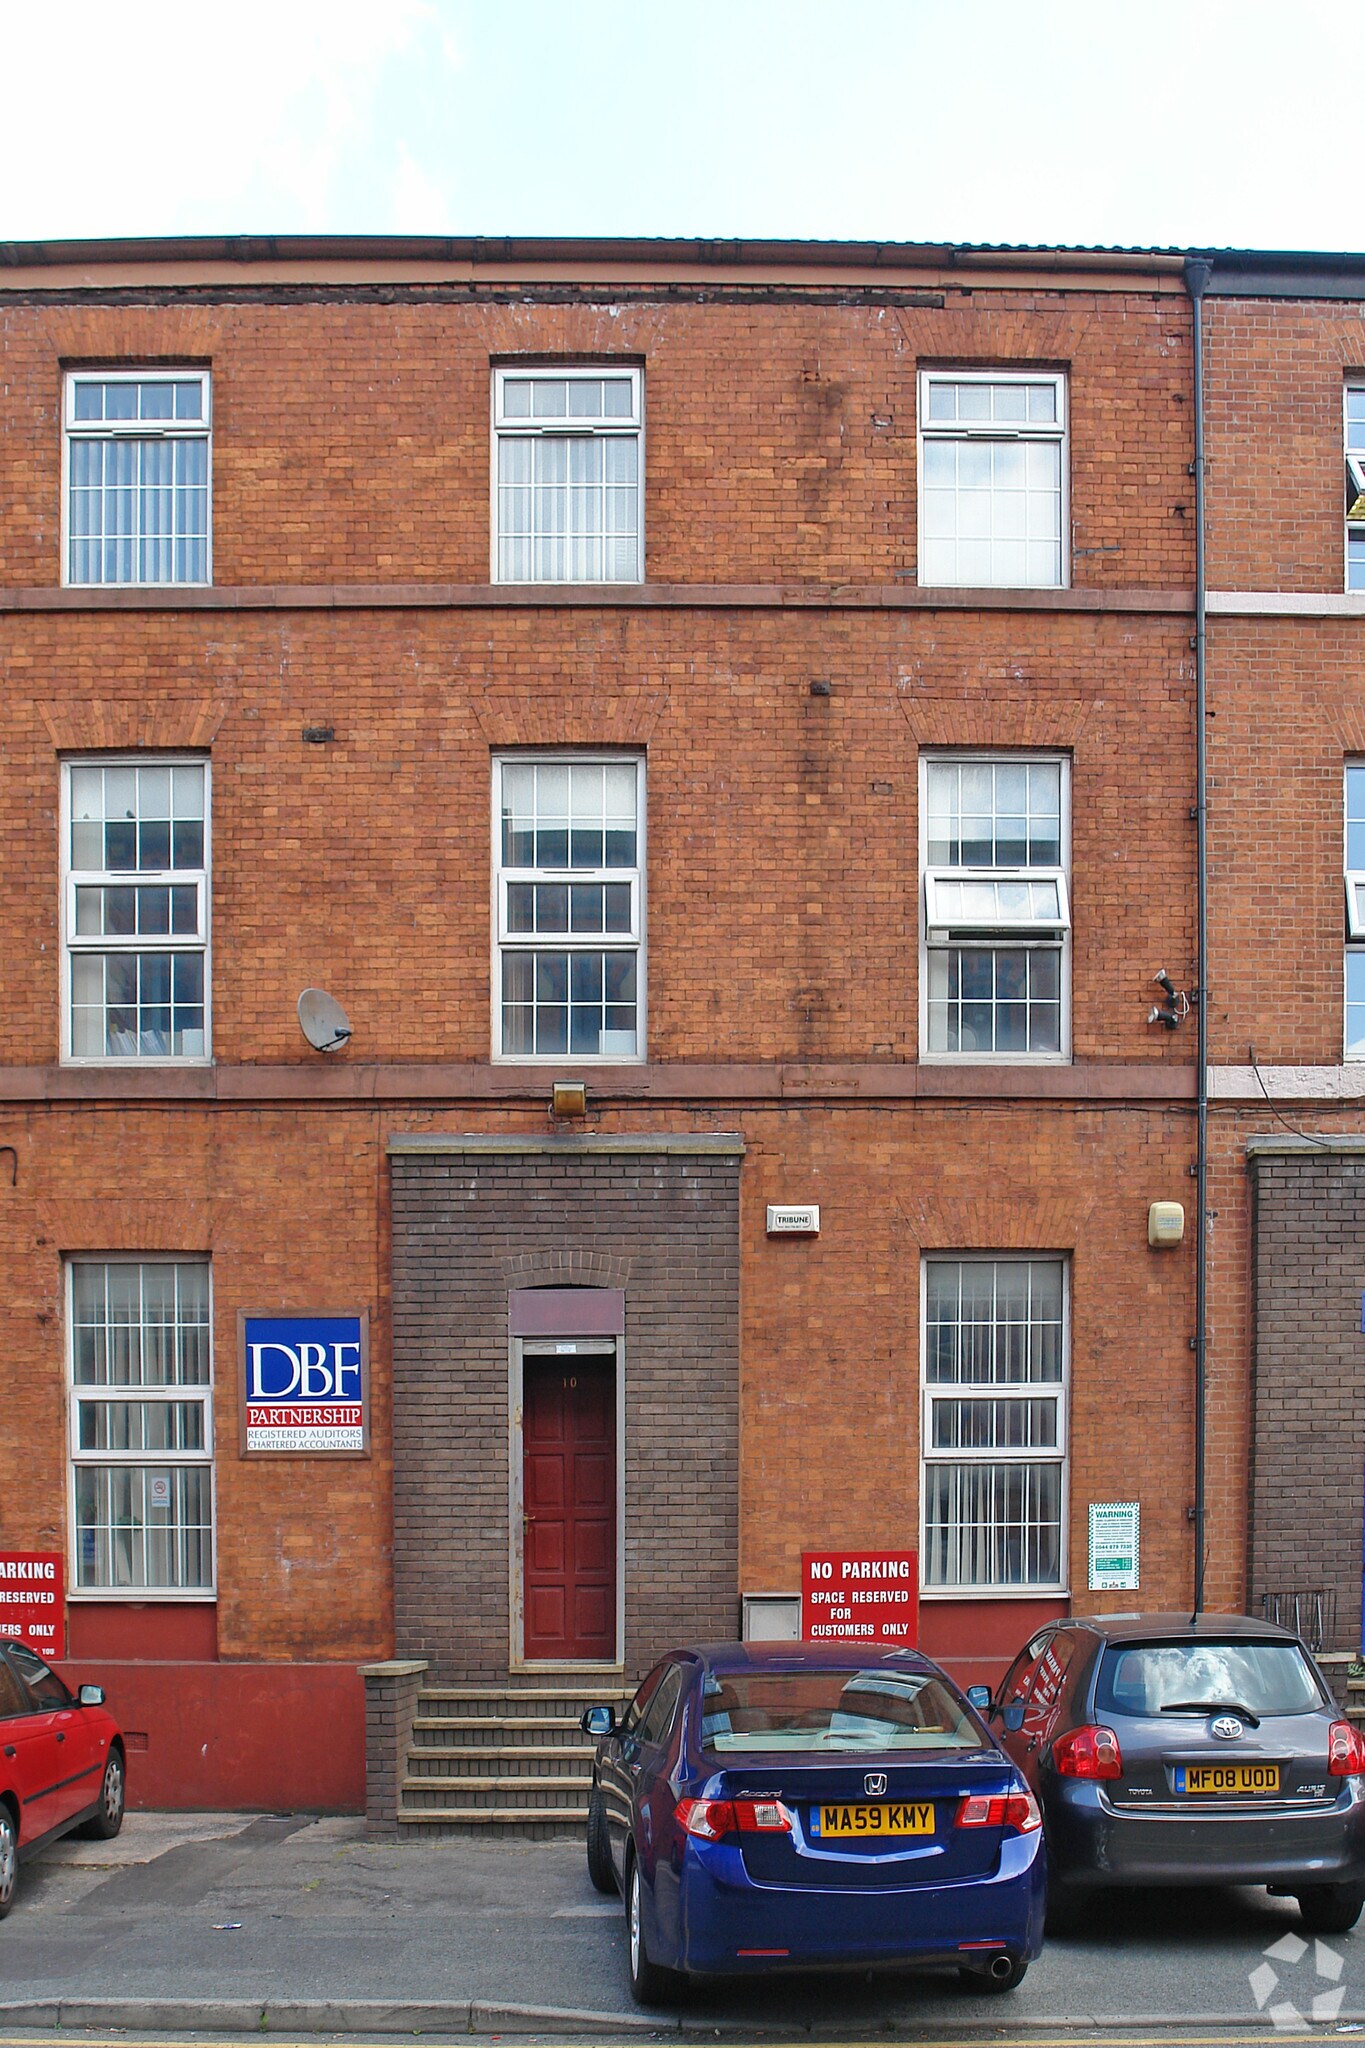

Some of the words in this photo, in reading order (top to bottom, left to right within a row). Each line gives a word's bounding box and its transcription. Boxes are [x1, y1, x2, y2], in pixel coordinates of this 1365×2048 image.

[247, 1342, 360, 1397] DBF
[562, 1376, 577, 1388] 10
[249, 1408, 360, 1425] PARTNERSHIP
[248, 1429, 307, 1439] REGISTERED
[309, 1429, 361, 1438] AUDITORS
[247, 1440, 297, 1449] CHARTERED
[298, 1439, 362, 1448] ACCOUNTANTS
[1095, 1510, 1133, 1518] WARNING
[0, 1562, 55, 1579] ARKING
[811, 1562, 833, 1579] NO
[842, 1561, 909, 1579] PARKING
[0, 1592, 55, 1603] RESERVED
[811, 1592, 845, 1603] SPACE
[852, 1591, 909, 1603] RESERVED
[830, 1608, 851, 1619] FOR
[28, 1624, 55, 1636] ONLY
[811, 1624, 875, 1636] CUSTOMERS
[882, 1623, 909, 1635] ONLY
[1189, 1769, 1236, 1788] MF08
[1241, 1768, 1276, 1787] UOD
[824, 1807, 882, 1830] MA59
[888, 1806, 930, 1828] KMY
